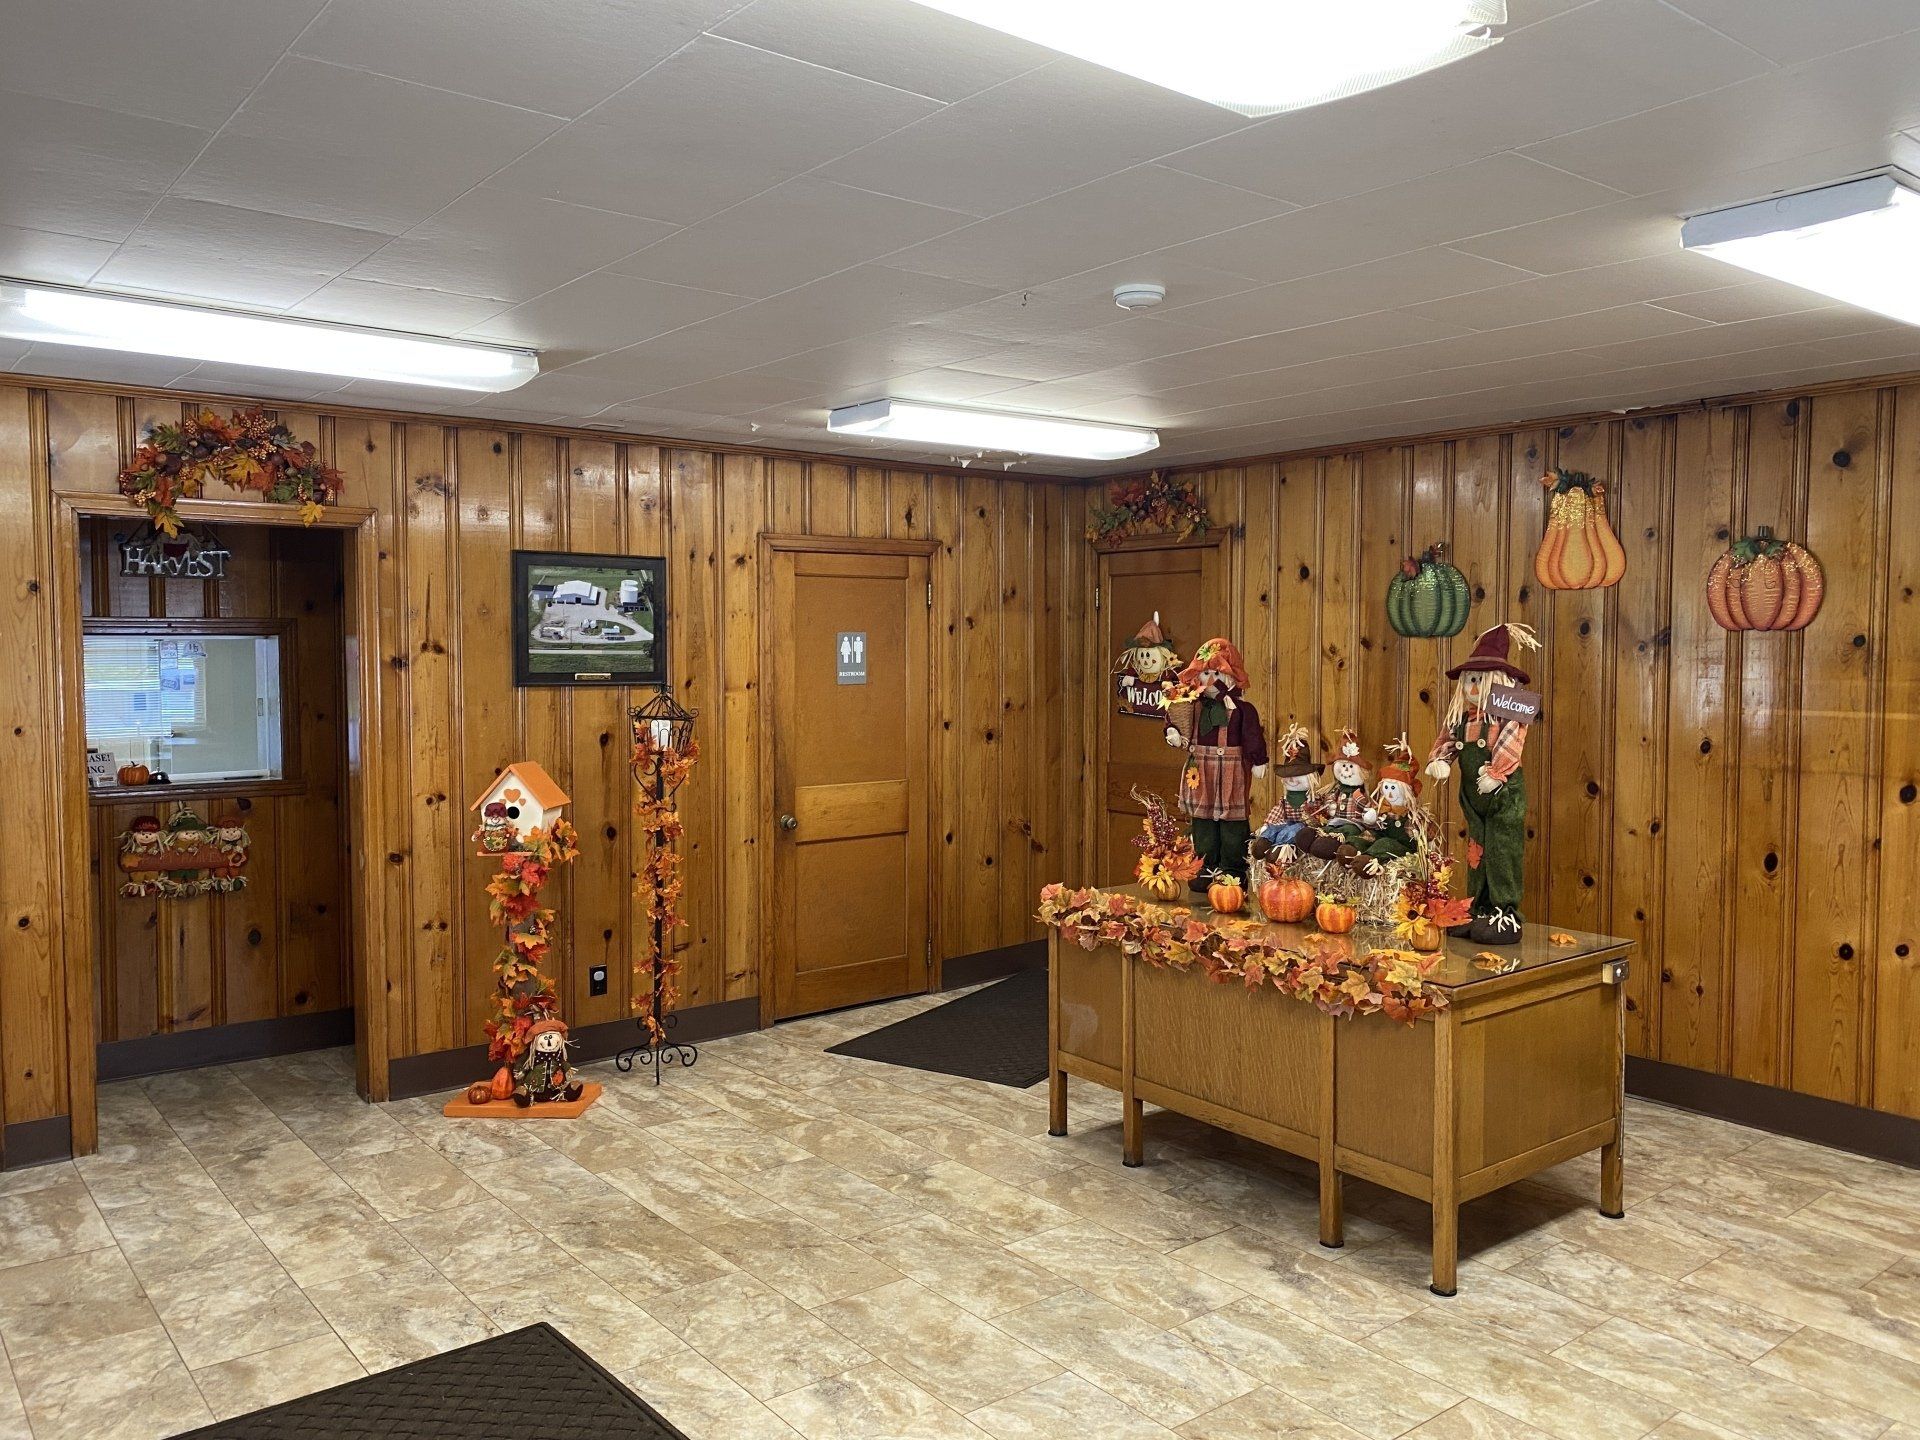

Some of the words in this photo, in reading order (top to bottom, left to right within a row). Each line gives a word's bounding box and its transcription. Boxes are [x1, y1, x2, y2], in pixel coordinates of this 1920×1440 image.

[123, 545, 232, 577] HARVEST
[1126, 686, 1163, 707] WELCO
[1491, 692, 1535, 715] Welcome
[87, 753, 111, 763] ASE!
